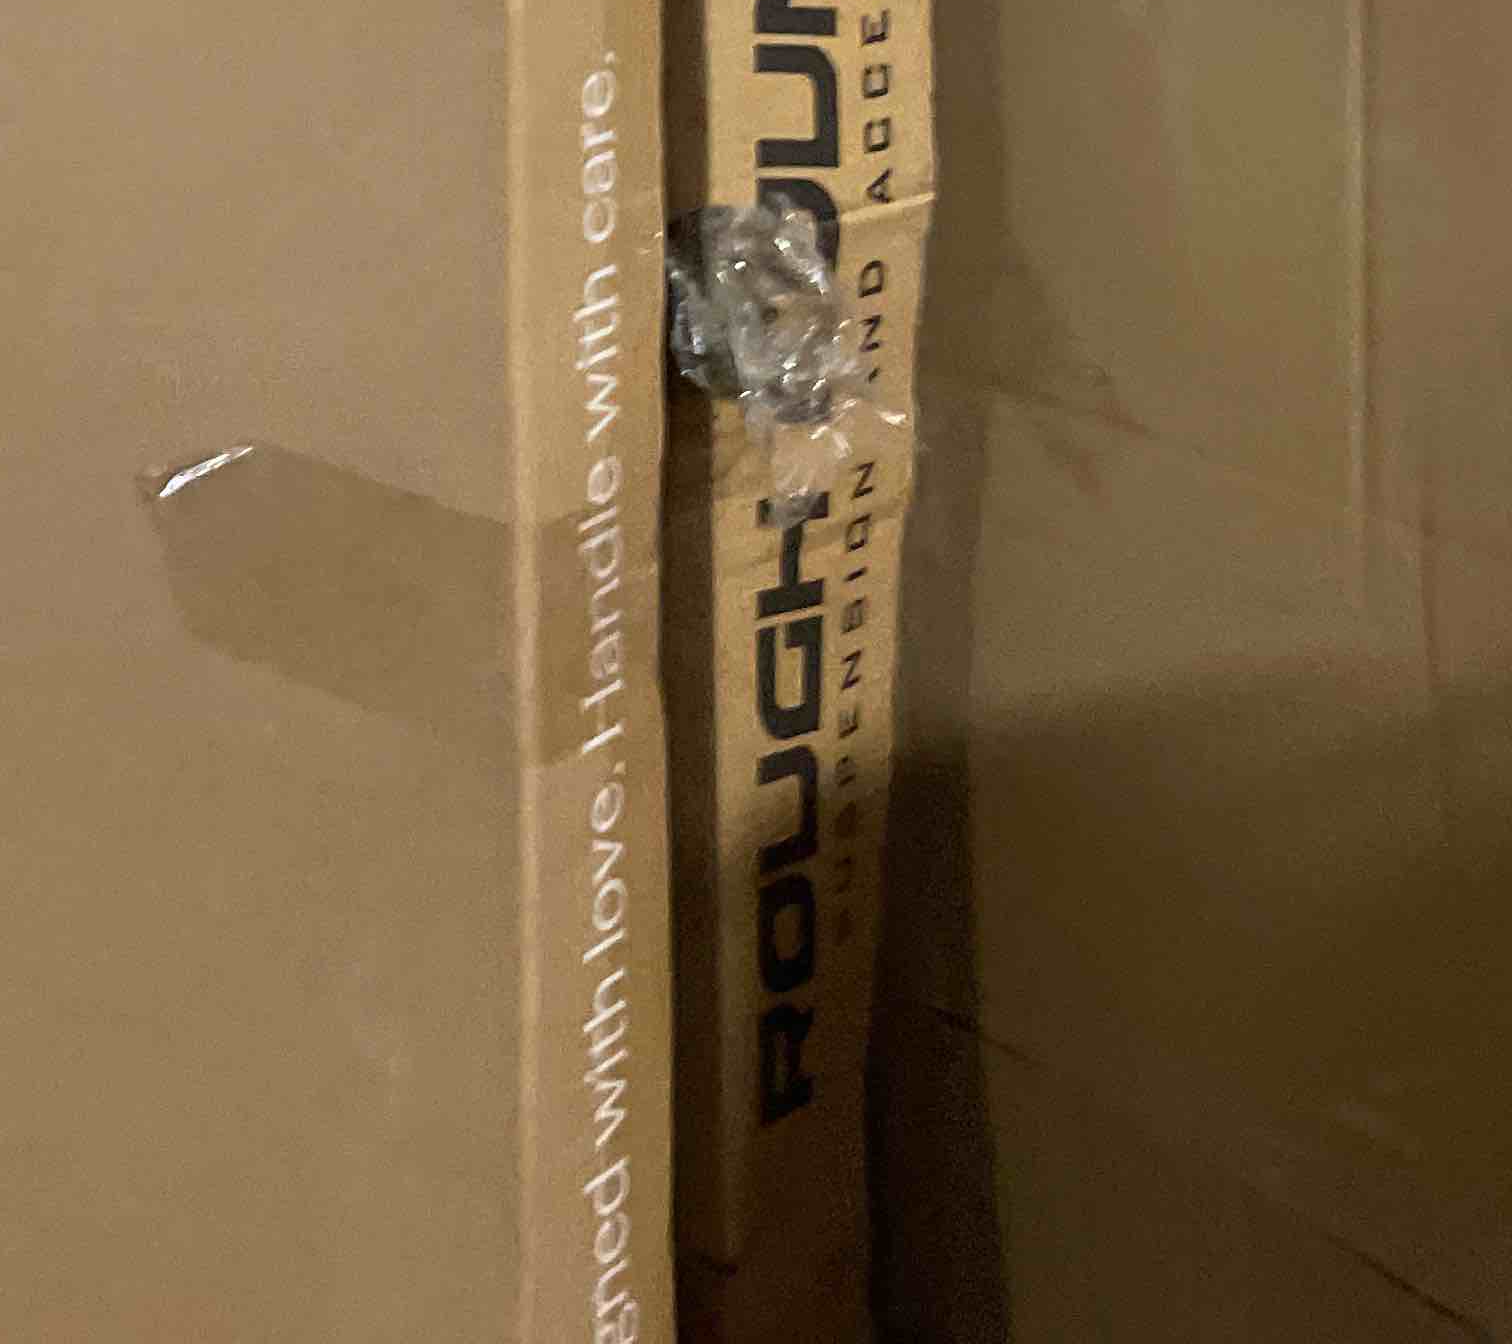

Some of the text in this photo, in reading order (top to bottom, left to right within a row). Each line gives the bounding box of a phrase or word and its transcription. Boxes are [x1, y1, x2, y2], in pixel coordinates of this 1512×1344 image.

[579, 50, 618, 244] care.
[571, 263, 624, 443] with
[857, 258, 885, 387] ND
[576, 457, 627, 759] Handle
[582, 761, 630, 964] love.
[756, 489, 834, 1128] ROUGH
[583, 965, 630, 1147] with
